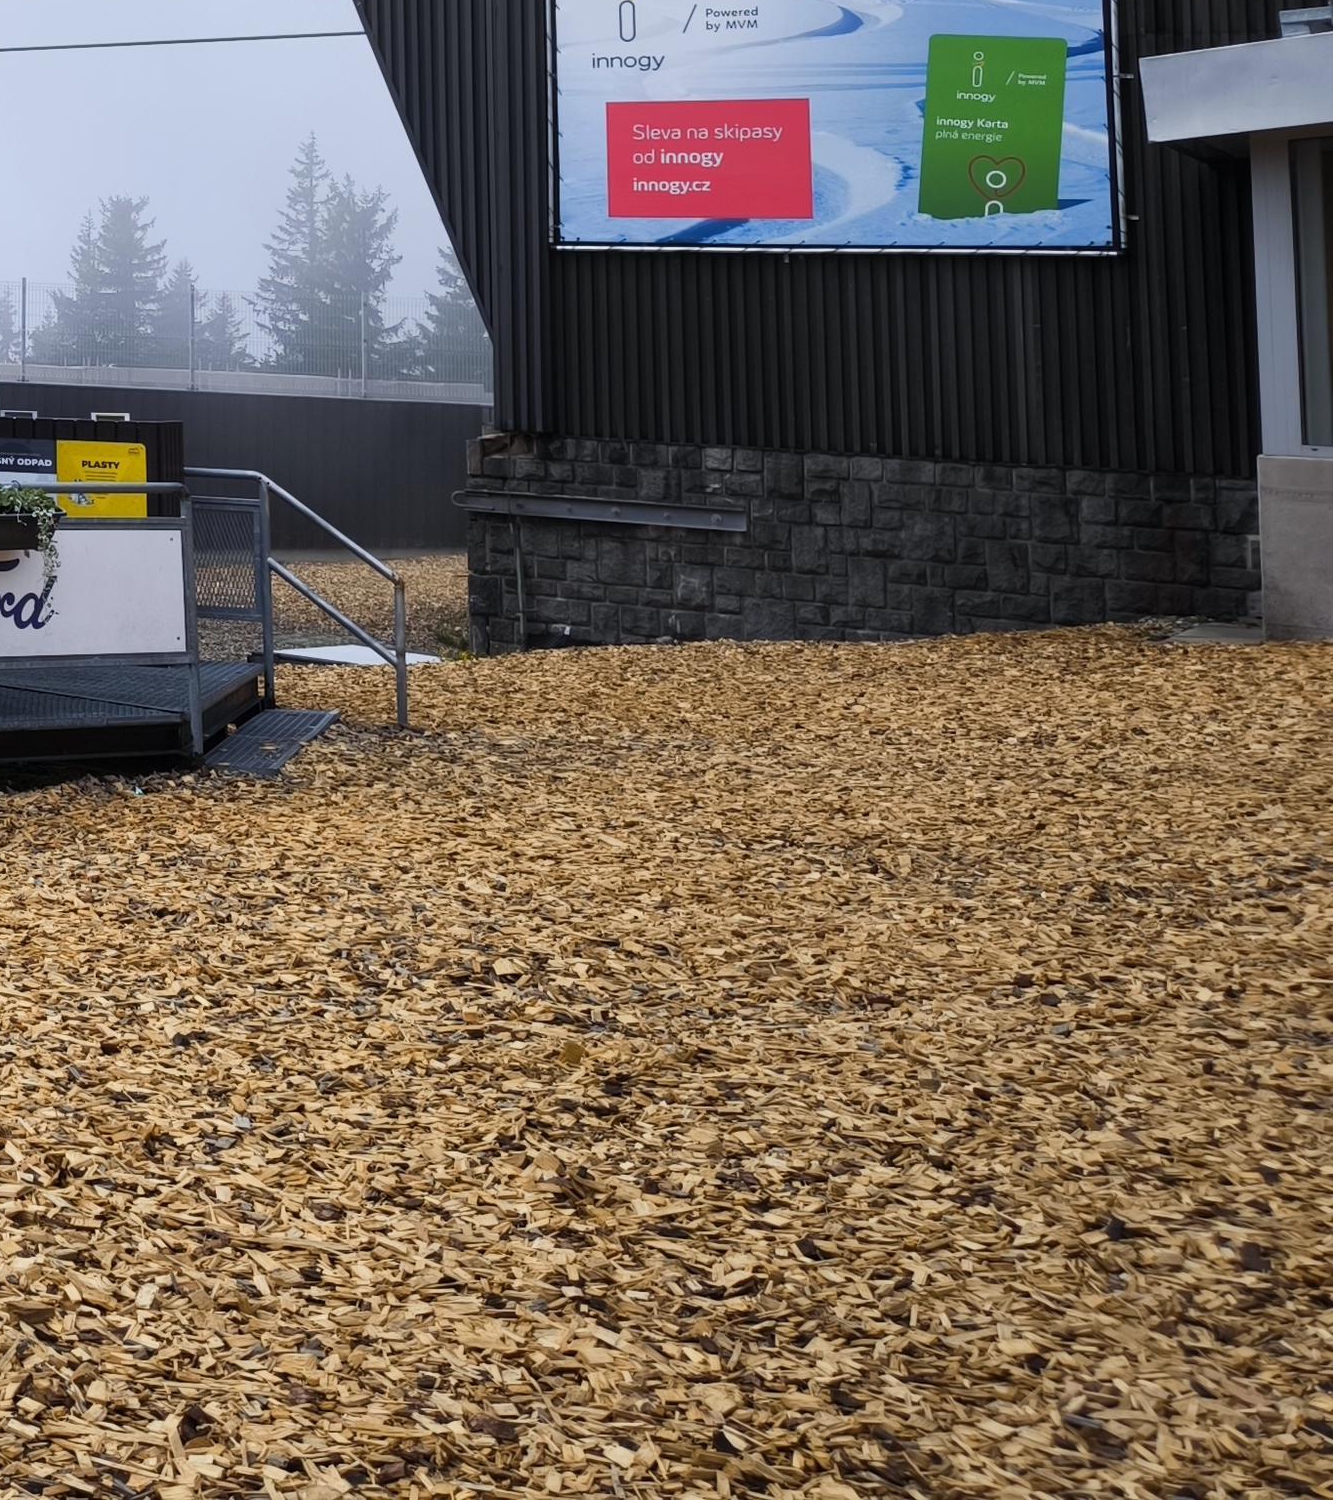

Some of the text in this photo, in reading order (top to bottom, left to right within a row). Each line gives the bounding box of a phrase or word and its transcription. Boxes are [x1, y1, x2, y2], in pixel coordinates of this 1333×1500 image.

[705, 6, 759, 19] Powered
[705, 19, 759, 33] by MVM
[591, 53, 666, 72] innogy
[956, 90, 997, 103] innogy
[936, 116, 1009, 130] innogy Karta
[632, 123, 783, 142] Sleva na skipasy
[935, 128, 1003, 144] plná energie
[632, 148, 724, 168] od innogy
[632, 177, 712, 195] innogy.cz
[17, 458, 53, 468] ODPAD
[81, 460, 120, 470] PLASTY
